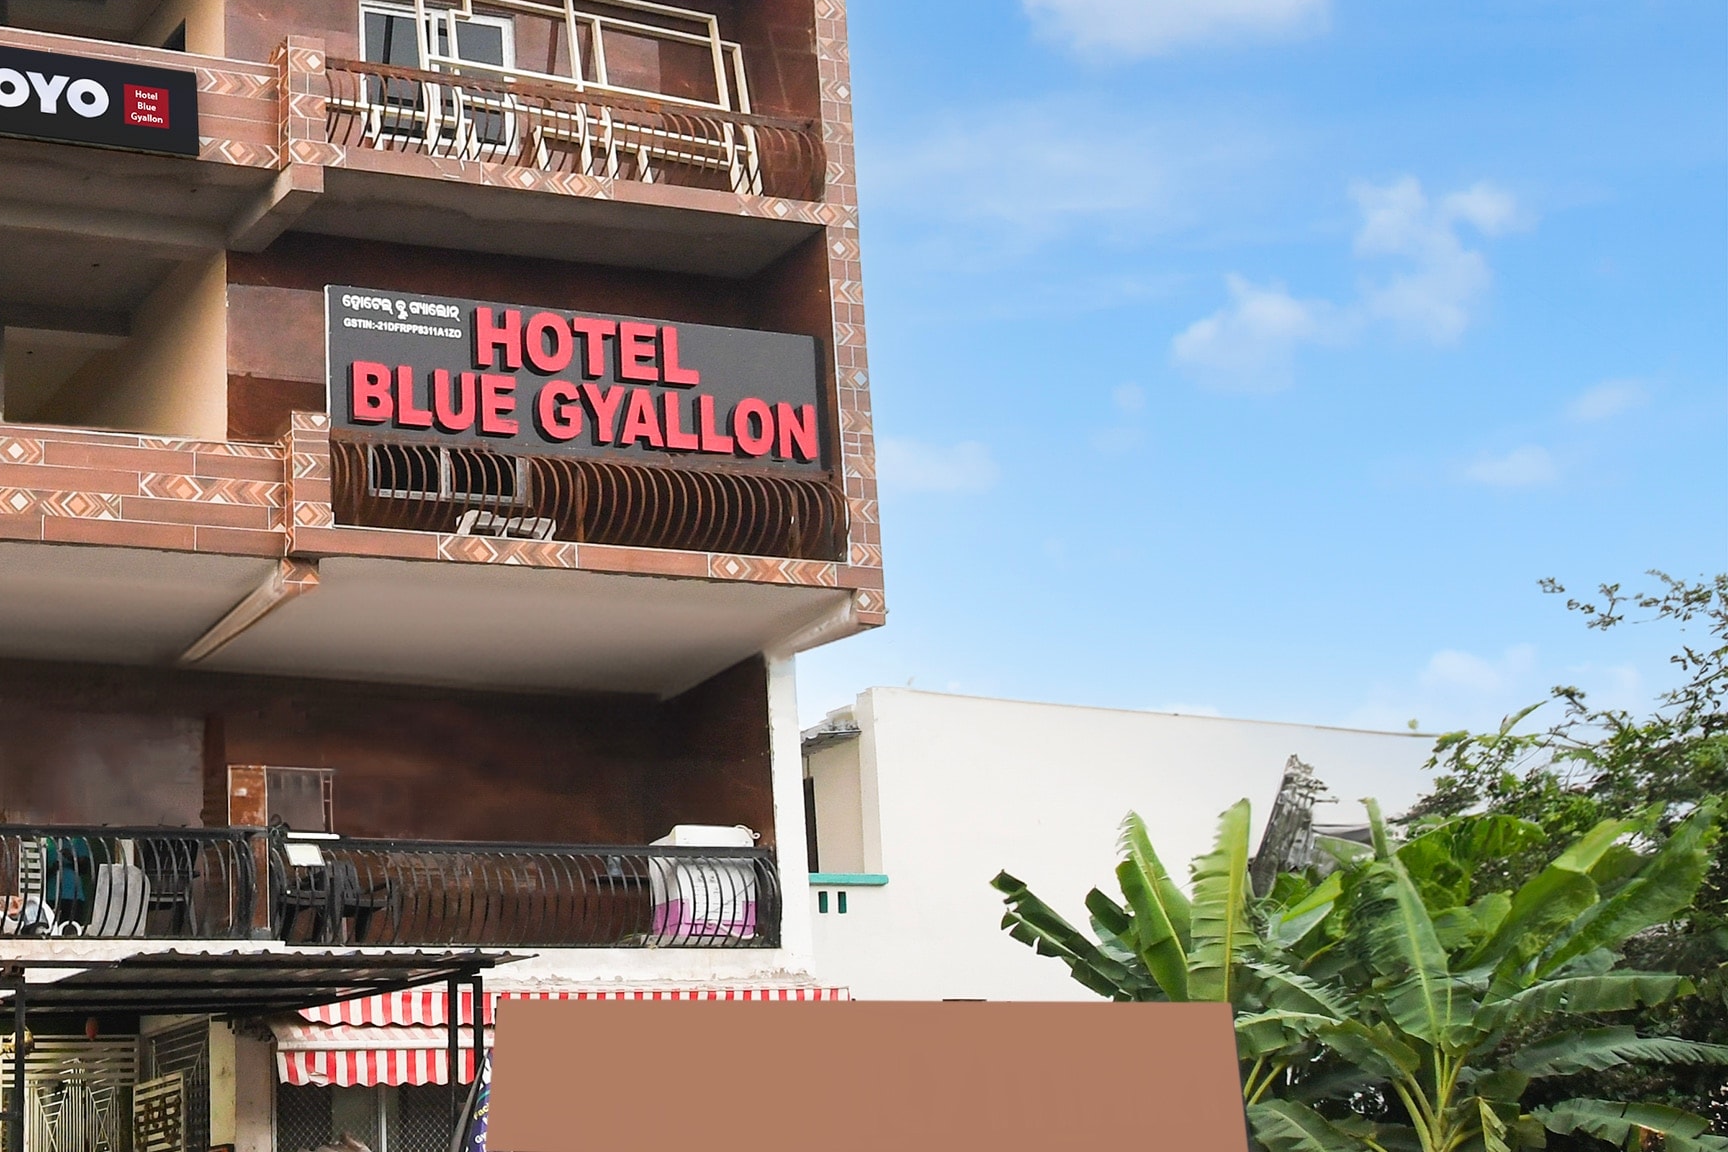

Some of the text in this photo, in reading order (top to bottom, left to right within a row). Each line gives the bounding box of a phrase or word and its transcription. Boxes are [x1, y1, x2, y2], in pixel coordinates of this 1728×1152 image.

[135, 89, 158, 100] Hotel
[137, 101, 157, 111] Blue
[130, 111, 164, 124] Gyallon
[475, 305, 701, 386] HOTEL
[351, 359, 819, 461] BLUE GYALLON
